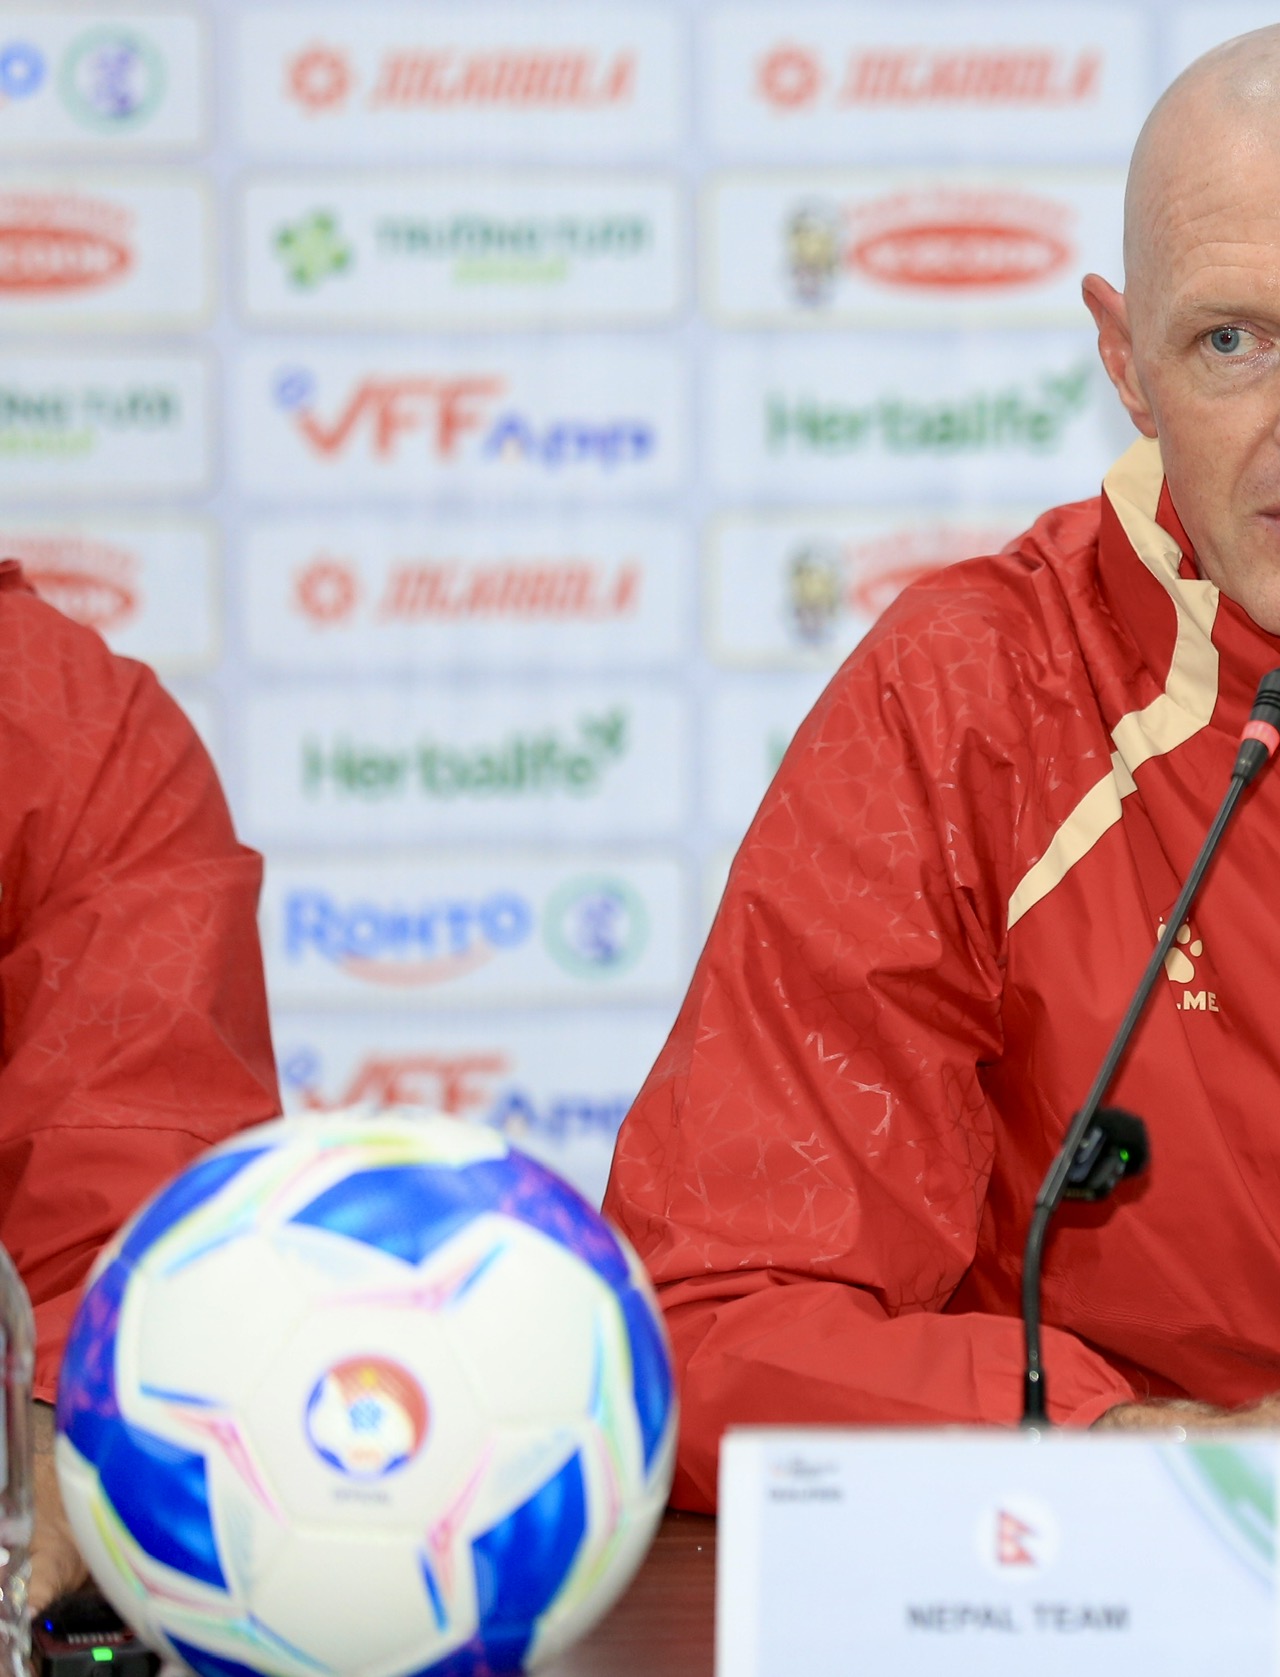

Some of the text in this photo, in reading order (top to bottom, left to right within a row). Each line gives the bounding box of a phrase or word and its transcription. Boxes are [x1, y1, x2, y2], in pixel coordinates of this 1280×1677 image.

[295, 374, 506, 463] VFF
[1176, 990, 1219, 1012] ME
[906, 1602, 1131, 1634] NEPAL TEAM
